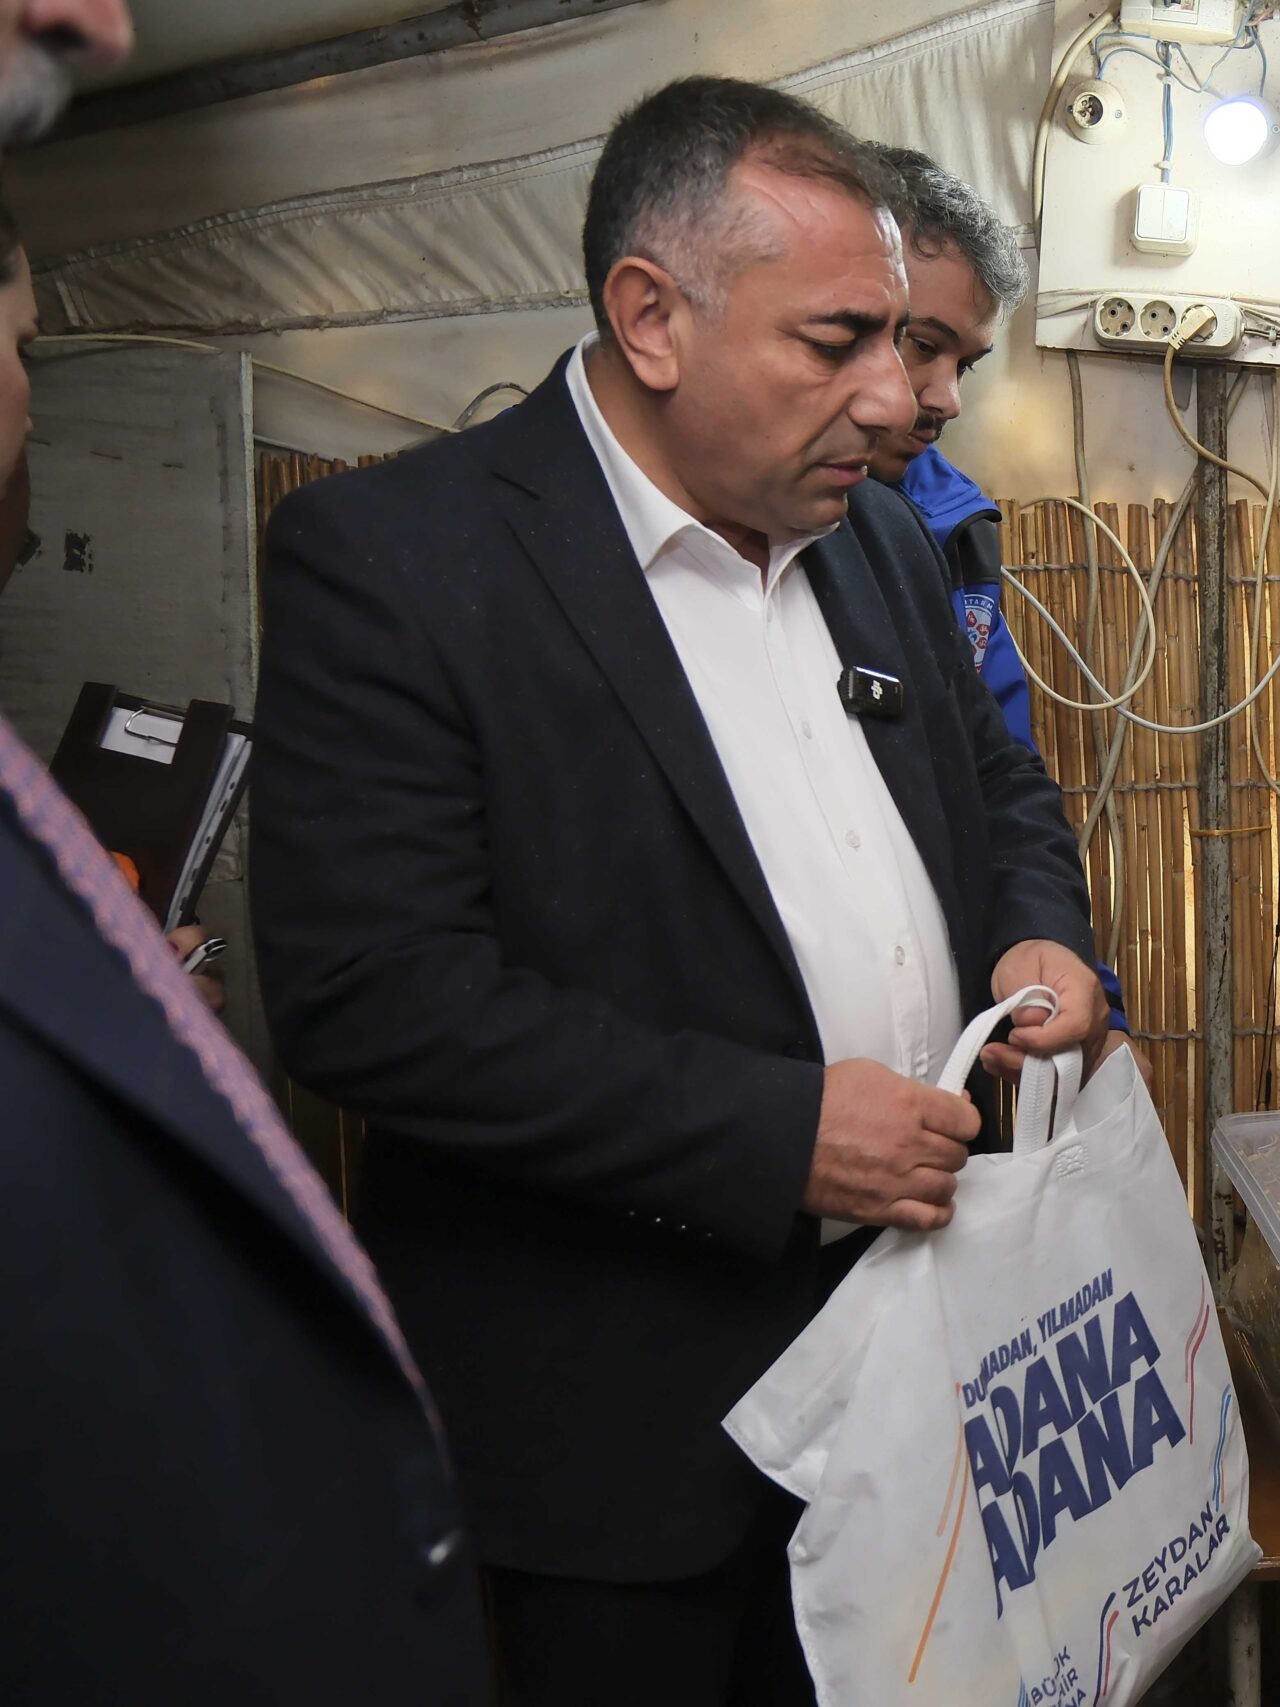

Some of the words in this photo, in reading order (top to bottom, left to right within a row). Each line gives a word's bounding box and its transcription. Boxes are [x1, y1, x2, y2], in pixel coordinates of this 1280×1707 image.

[1037, 1267, 1113, 1343] YILMADAN
[964, 1291, 1161, 1511] ADANA
[981, 1366, 1187, 1620] ADANA
[1122, 1501, 1213, 1608] ZEYDAN
[1131, 1514, 1230, 1637] KARALAR
